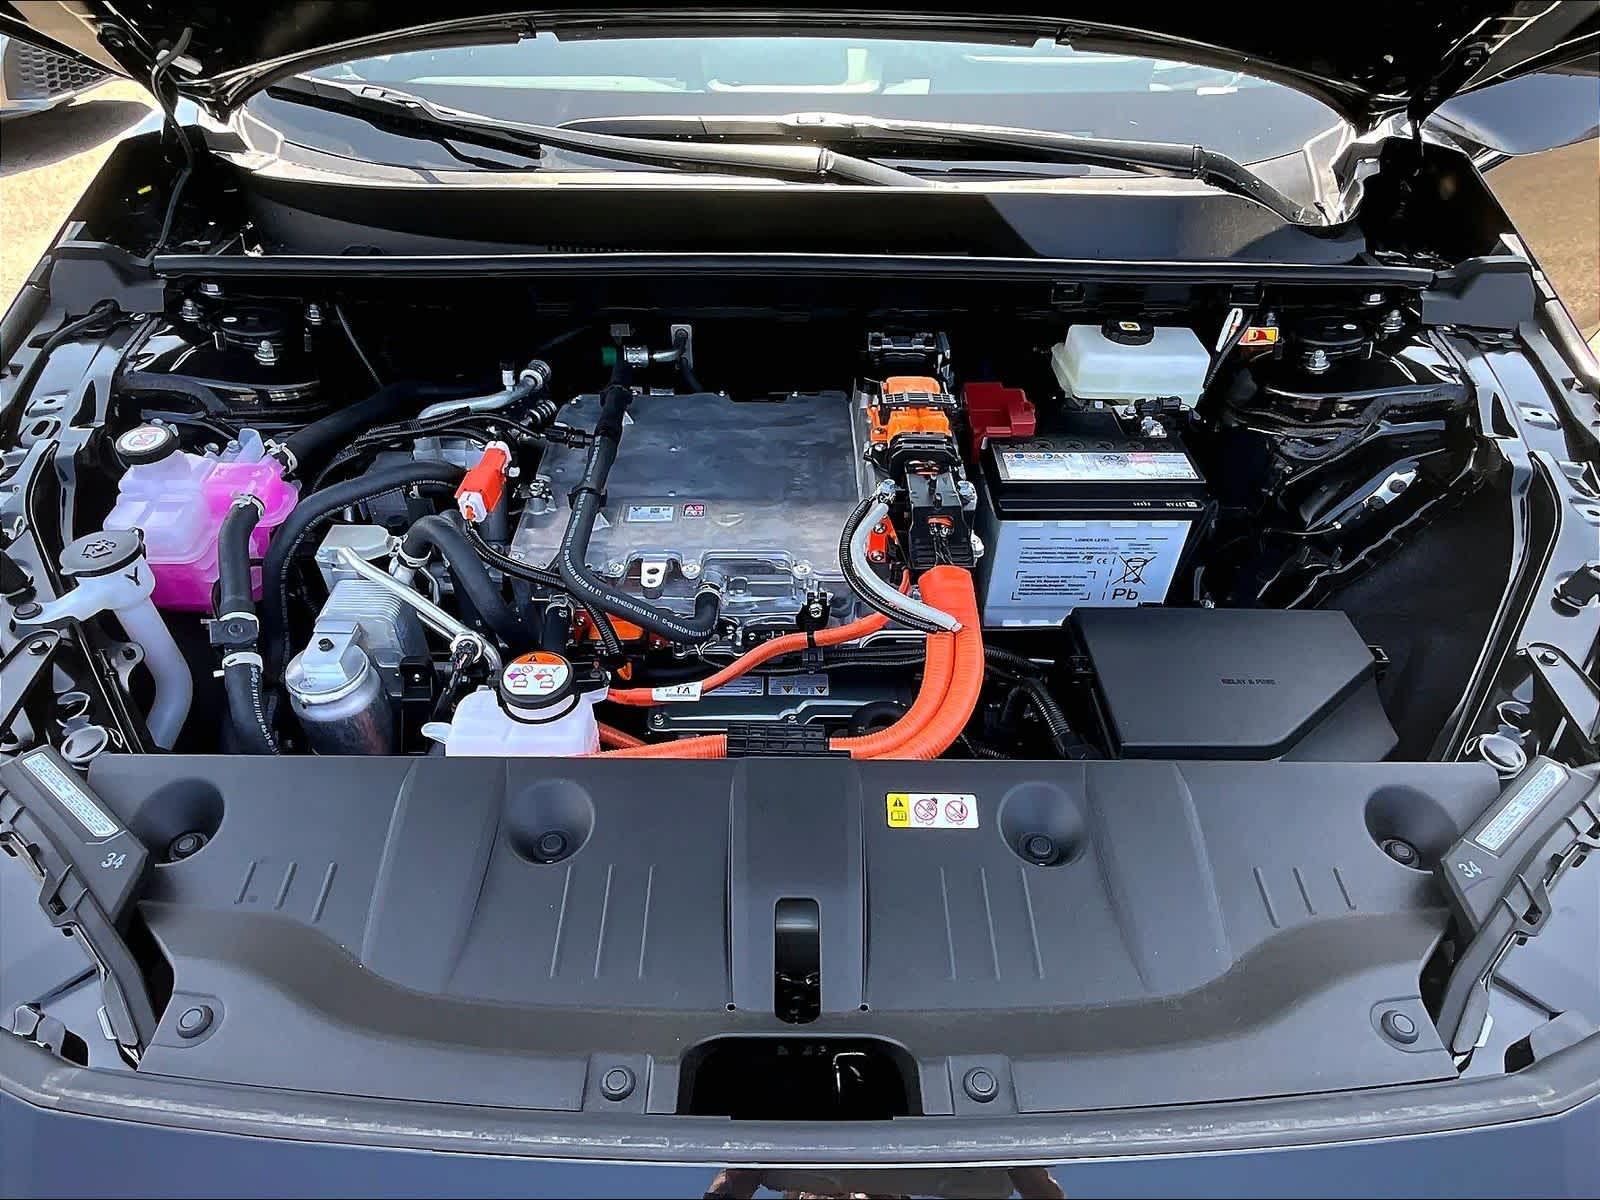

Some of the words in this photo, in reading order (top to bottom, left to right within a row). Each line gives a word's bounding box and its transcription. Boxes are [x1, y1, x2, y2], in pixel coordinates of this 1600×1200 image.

[1112, 588, 1139, 601] Pb
[101, 852, 127, 870] 34
[1457, 860, 1483, 878] 34
